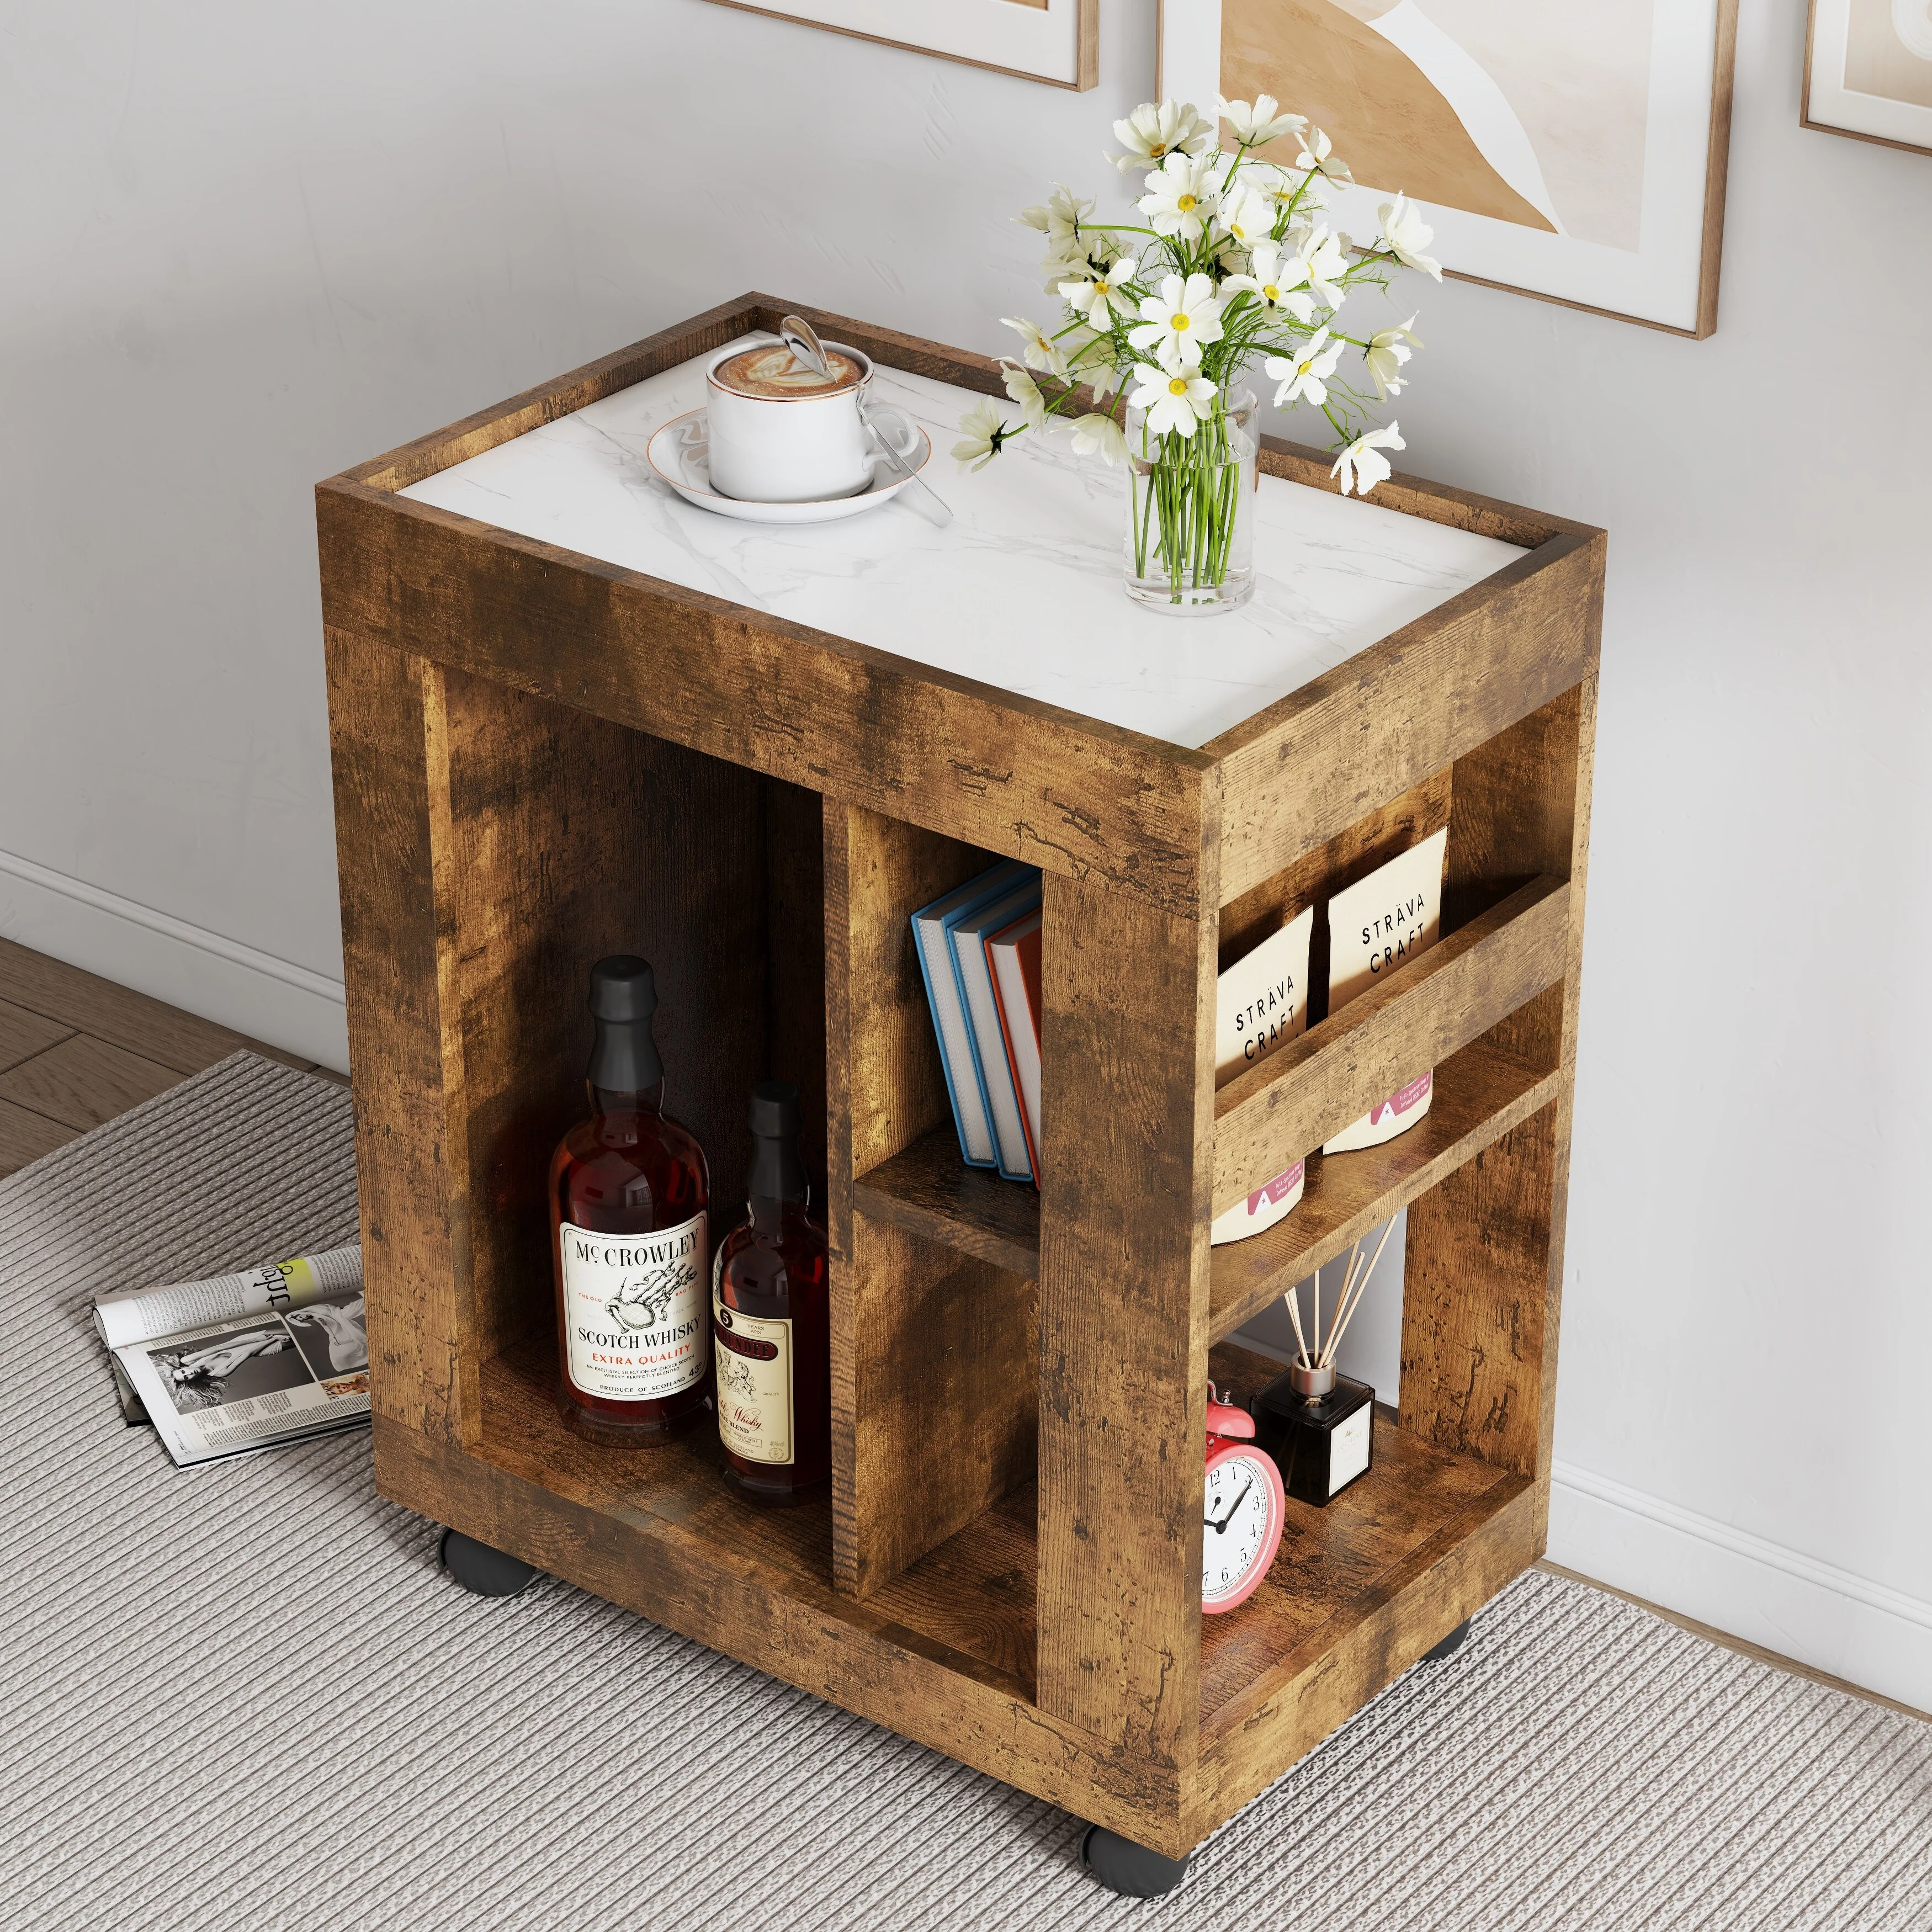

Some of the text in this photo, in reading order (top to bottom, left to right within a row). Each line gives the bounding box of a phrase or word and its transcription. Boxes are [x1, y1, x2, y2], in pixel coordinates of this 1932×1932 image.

[1362, 893, 1424, 944] STRÄVA
[1370, 922, 1423, 973] CRAFT
[1236, 975, 1294, 1031] STRÄVA
[1245, 1005, 1293, 1060] CRAFT
[1399, 1083, 1420, 1101] Full-Spectrum
[1400, 1098, 1413, 1108] Infused
[604, 1228, 699, 1267] CROWLEY
[689, 1281, 698, 1290] PIPE
[723, 1312, 729, 1324] 5
[578, 1314, 701, 1349] SCOTCH WHISKY
[721, 1329, 769, 1357] DUNDEE
[592, 1343, 691, 1365] EXTRA QUALITY
[678, 1354, 694, 1365] SCOTCH
[657, 1367, 680, 1376] BLENDED
[651, 1377, 686, 1390] SCOTLAND
[730, 1402, 763, 1431] Whisky
[729, 1420, 749, 1434] BLEND
[733, 1442, 754, 1453] SCOTLAND
[1210, 1469, 1220, 1488] 12
[1233, 1466, 1236, 1480] 1
[1245, 1475, 1252, 1490] 2
[1253, 1496, 1260, 1511] 3
[1250, 1524, 1256, 1537] 4
[1240, 1548, 1246, 1563] 5
[1203, 1571, 1209, 1586] 7
[1222, 1567, 1228, 1582] 6
